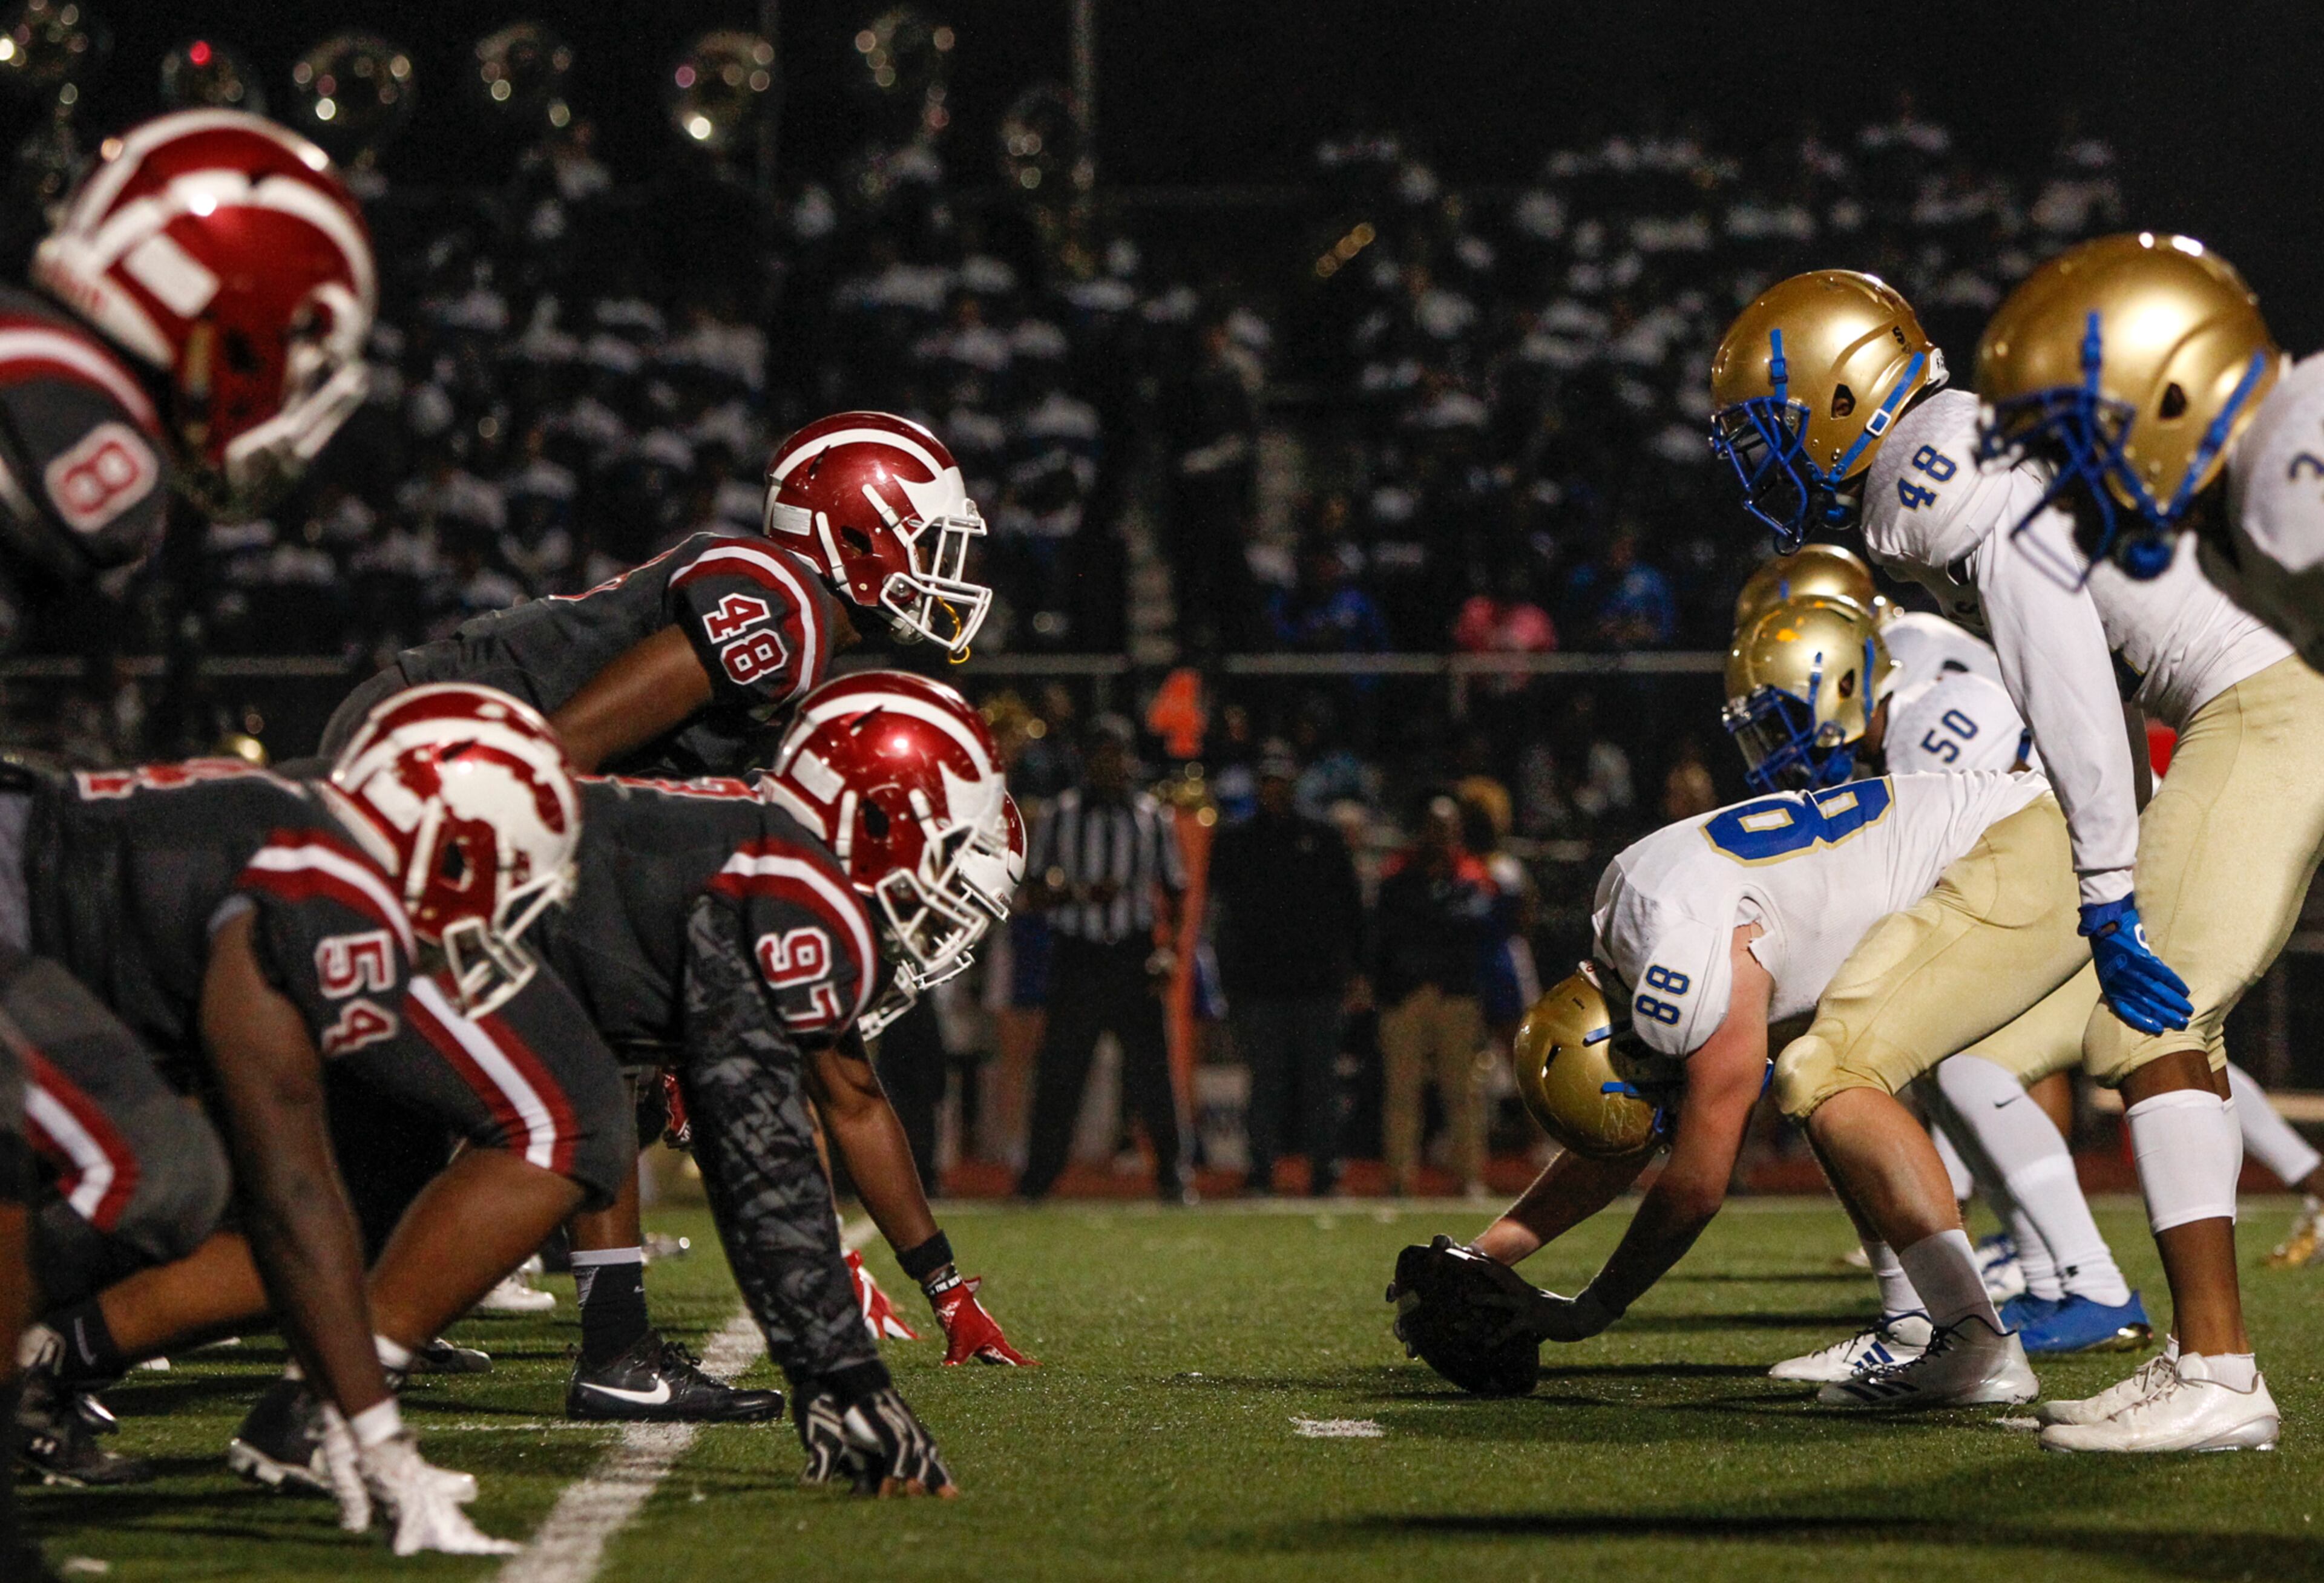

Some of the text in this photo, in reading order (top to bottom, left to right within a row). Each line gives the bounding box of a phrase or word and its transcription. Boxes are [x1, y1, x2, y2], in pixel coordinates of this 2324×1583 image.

[1896, 443, 1960, 513] 48
[703, 593, 789, 685] 48
[1919, 709, 1980, 764] 50
[315, 930, 397, 1057] 54
[756, 926, 842, 1034] 97
[1635, 963, 1693, 1028] 88
